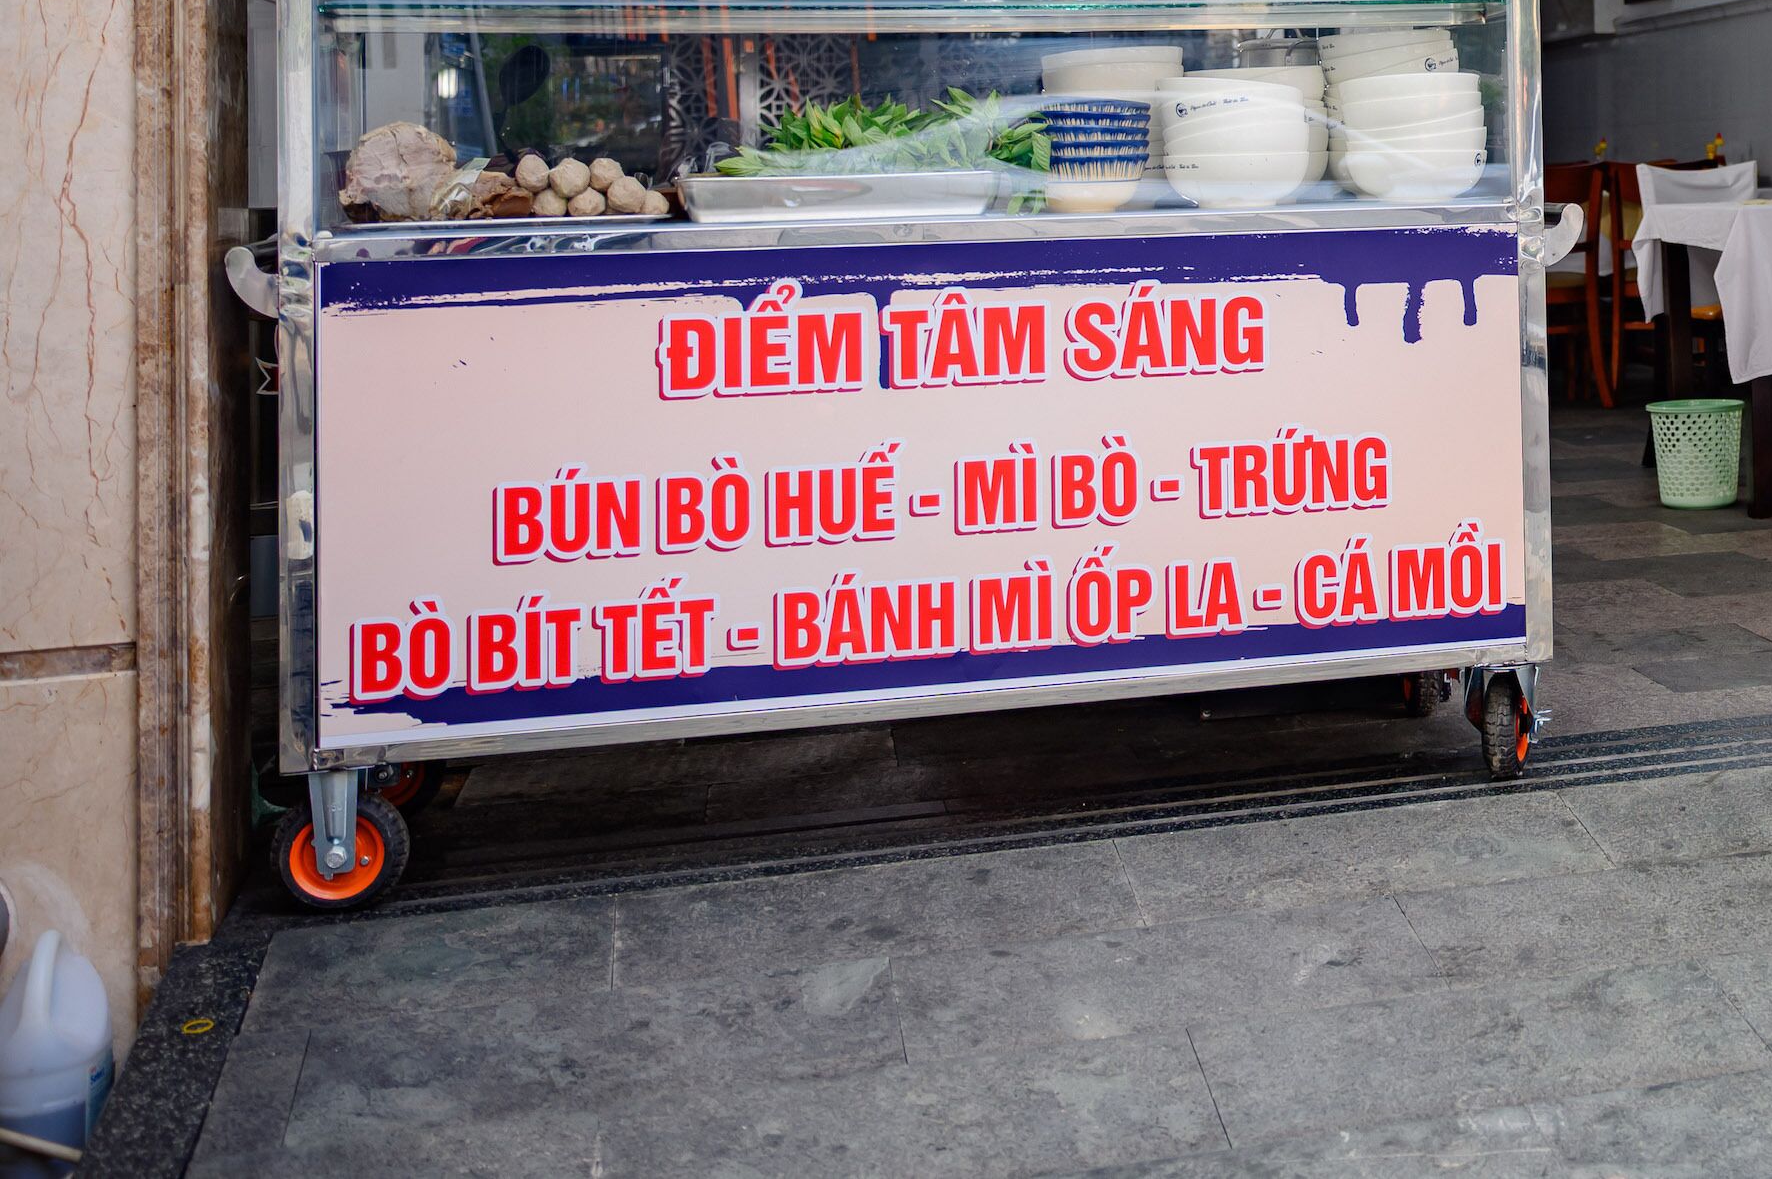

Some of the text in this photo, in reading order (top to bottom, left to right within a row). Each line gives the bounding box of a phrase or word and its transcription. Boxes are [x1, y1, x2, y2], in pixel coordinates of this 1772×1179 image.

[664, 281, 1267, 395] ĐIỂM TÂM SÁNG
[499, 464, 643, 561] BÚN
[663, 453, 752, 551] BÒ
[771, 438, 898, 543] HUẾ
[960, 440, 1038, 531] MÌ
[1057, 432, 1139, 525] BÒ
[1196, 425, 1390, 516] TRỨNG
[358, 598, 453, 699] BÒ
[474, 592, 584, 689] BÍT
[600, 574, 718, 678] TẾT
[780, 569, 958, 664] BÁNH
[975, 560, 1055, 649] MÌ
[1070, 543, 1155, 641] ỐP
[1170, 560, 1244, 634] LA
[1299, 534, 1380, 624] CÁ
[1393, 520, 1505, 617] MỒI
